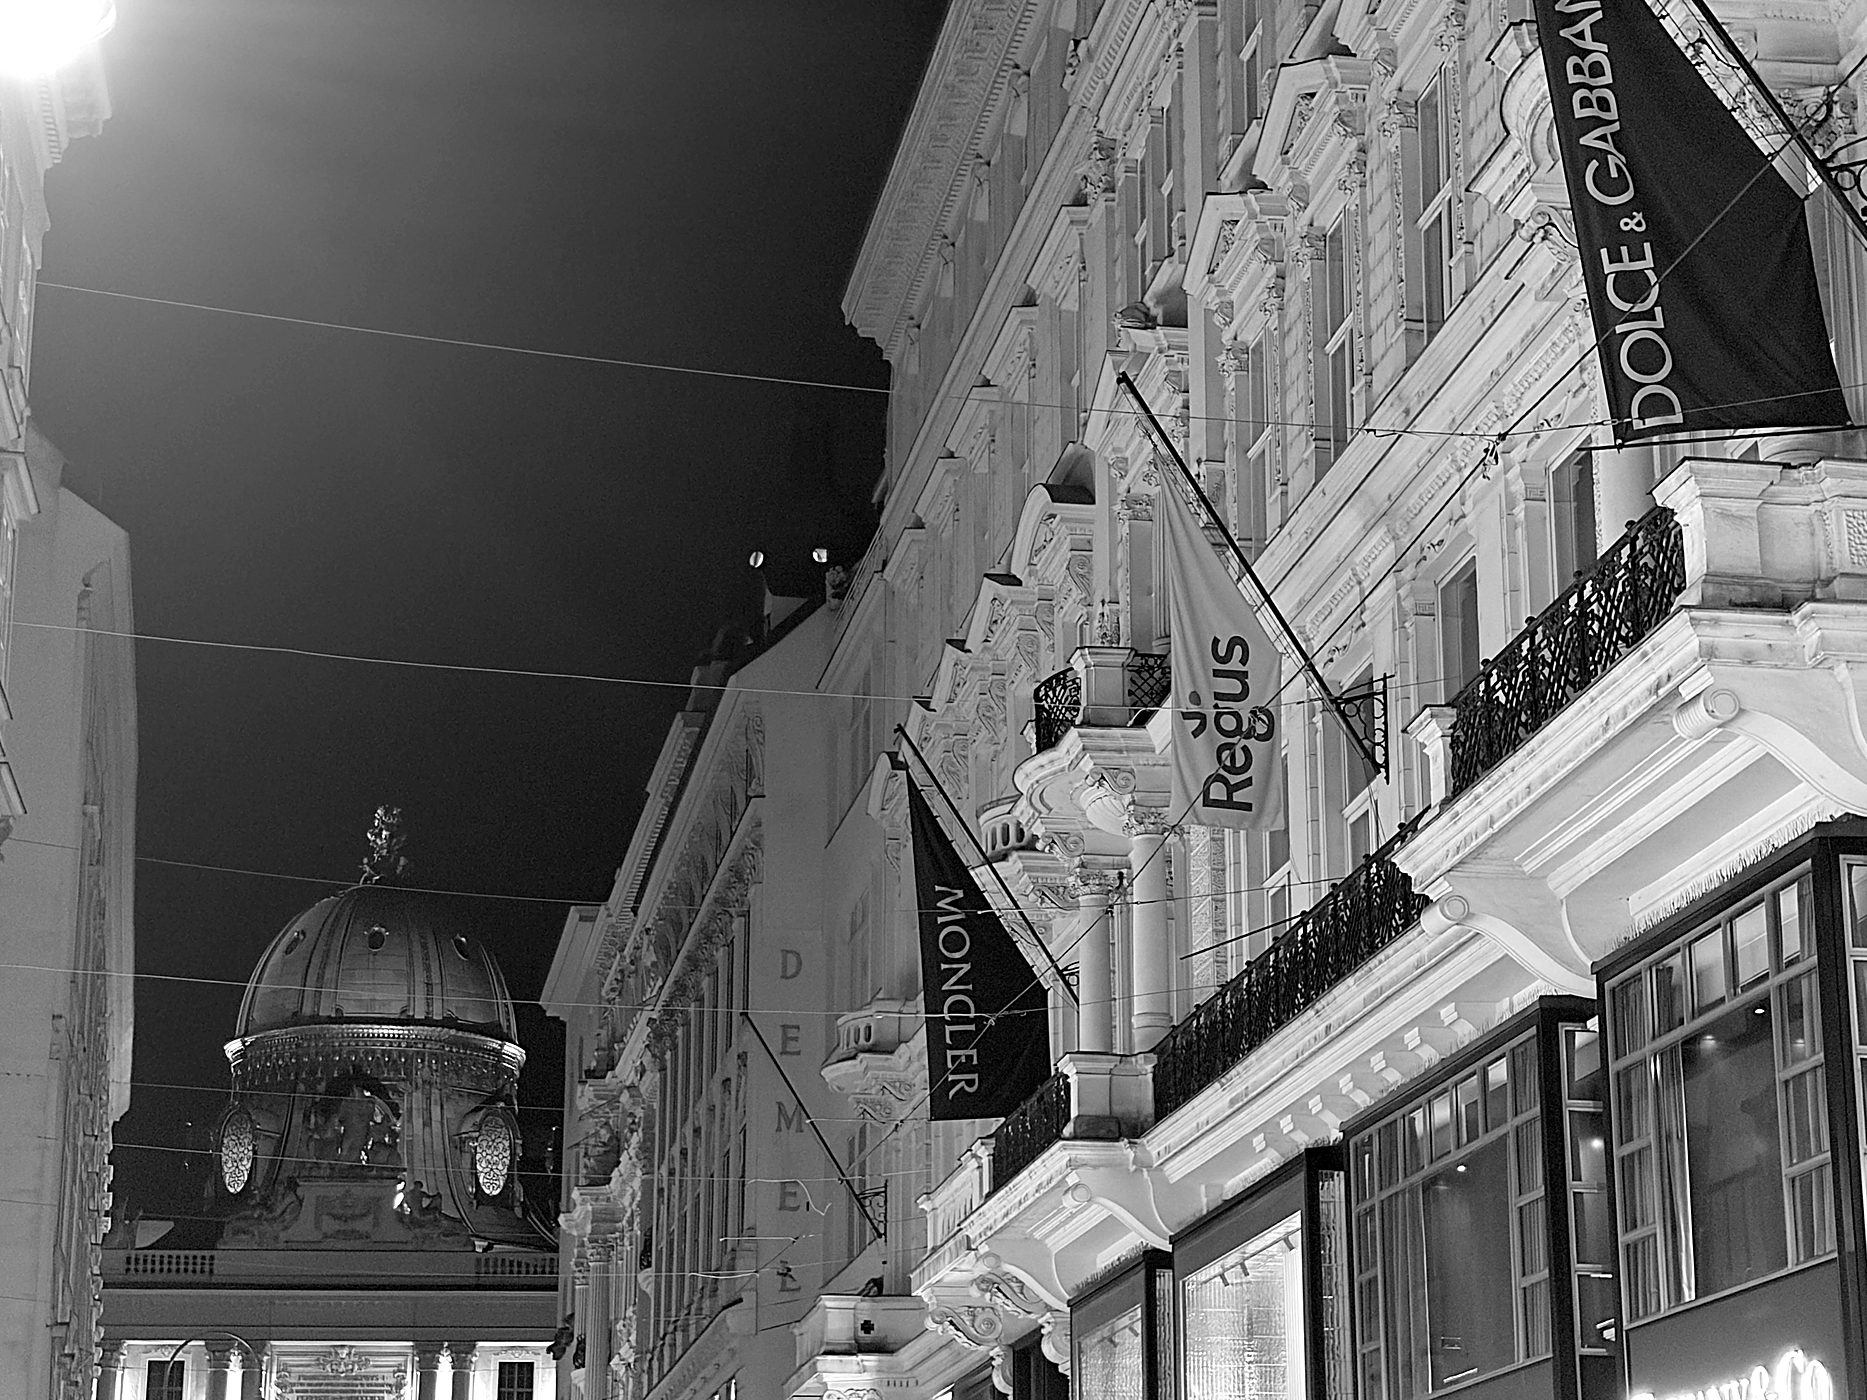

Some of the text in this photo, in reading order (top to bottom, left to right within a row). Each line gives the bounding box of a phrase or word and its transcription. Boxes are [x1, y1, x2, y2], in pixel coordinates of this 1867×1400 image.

[1619, 211, 1647, 233] &
[1601, 242, 1684, 430] DOLCE
[1202, 635, 1275, 812] Regus
[934, 884, 980, 1101] MONCLER
